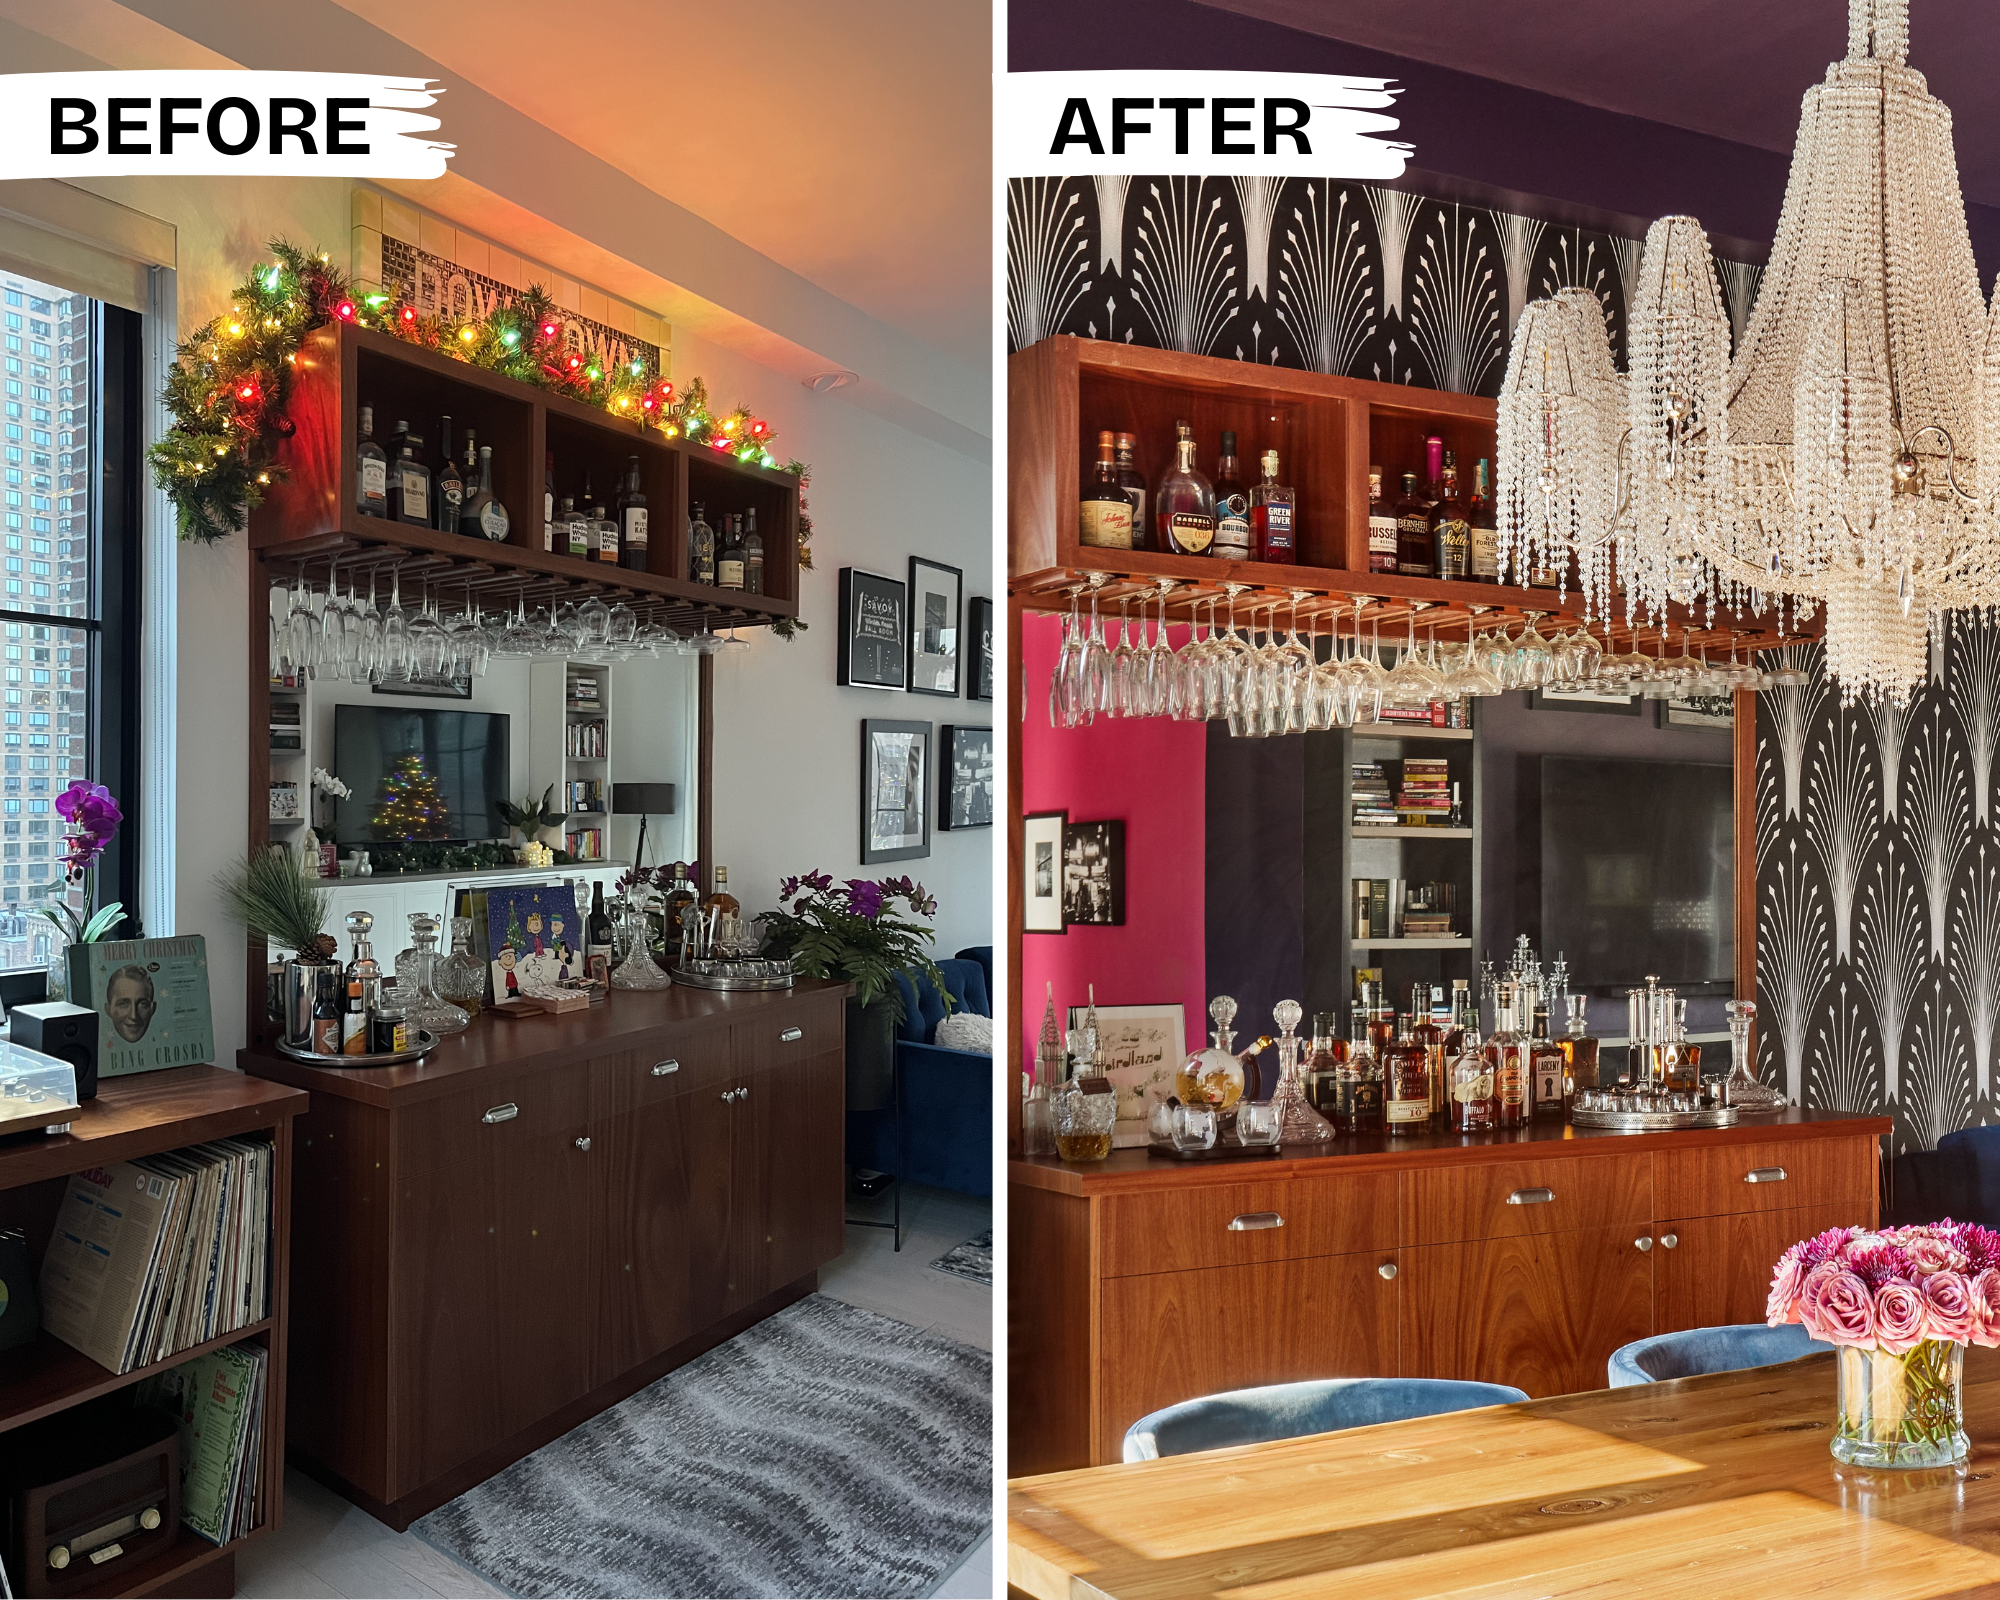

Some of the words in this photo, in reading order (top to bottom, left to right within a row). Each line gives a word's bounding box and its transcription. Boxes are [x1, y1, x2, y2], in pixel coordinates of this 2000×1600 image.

[1268, 507, 1291, 517] GREEN
[1176, 516, 1211, 525] BARRELL
[1269, 515, 1291, 525] RIVER
[572, 535, 581, 543] NY
[1132, 531, 1145, 539] ENT
[1194, 530, 1210, 540] 036
[1383, 557, 1392, 568] 10
[1453, 554, 1462, 562] 12
[867, 599, 893, 615] SAVOY
[103, 942, 137, 961] MERRY
[143, 940, 197, 959] CHRISTMAS
[110, 1049, 144, 1070] BING
[155, 1042, 205, 1065] CROSBY
[1537, 1060, 1560, 1072] LARCENY
[1409, 1109, 1422, 1118] 10
[1465, 1105, 1485, 1115] BUFFALO
[79, 1167, 115, 1189] OLIDAY
